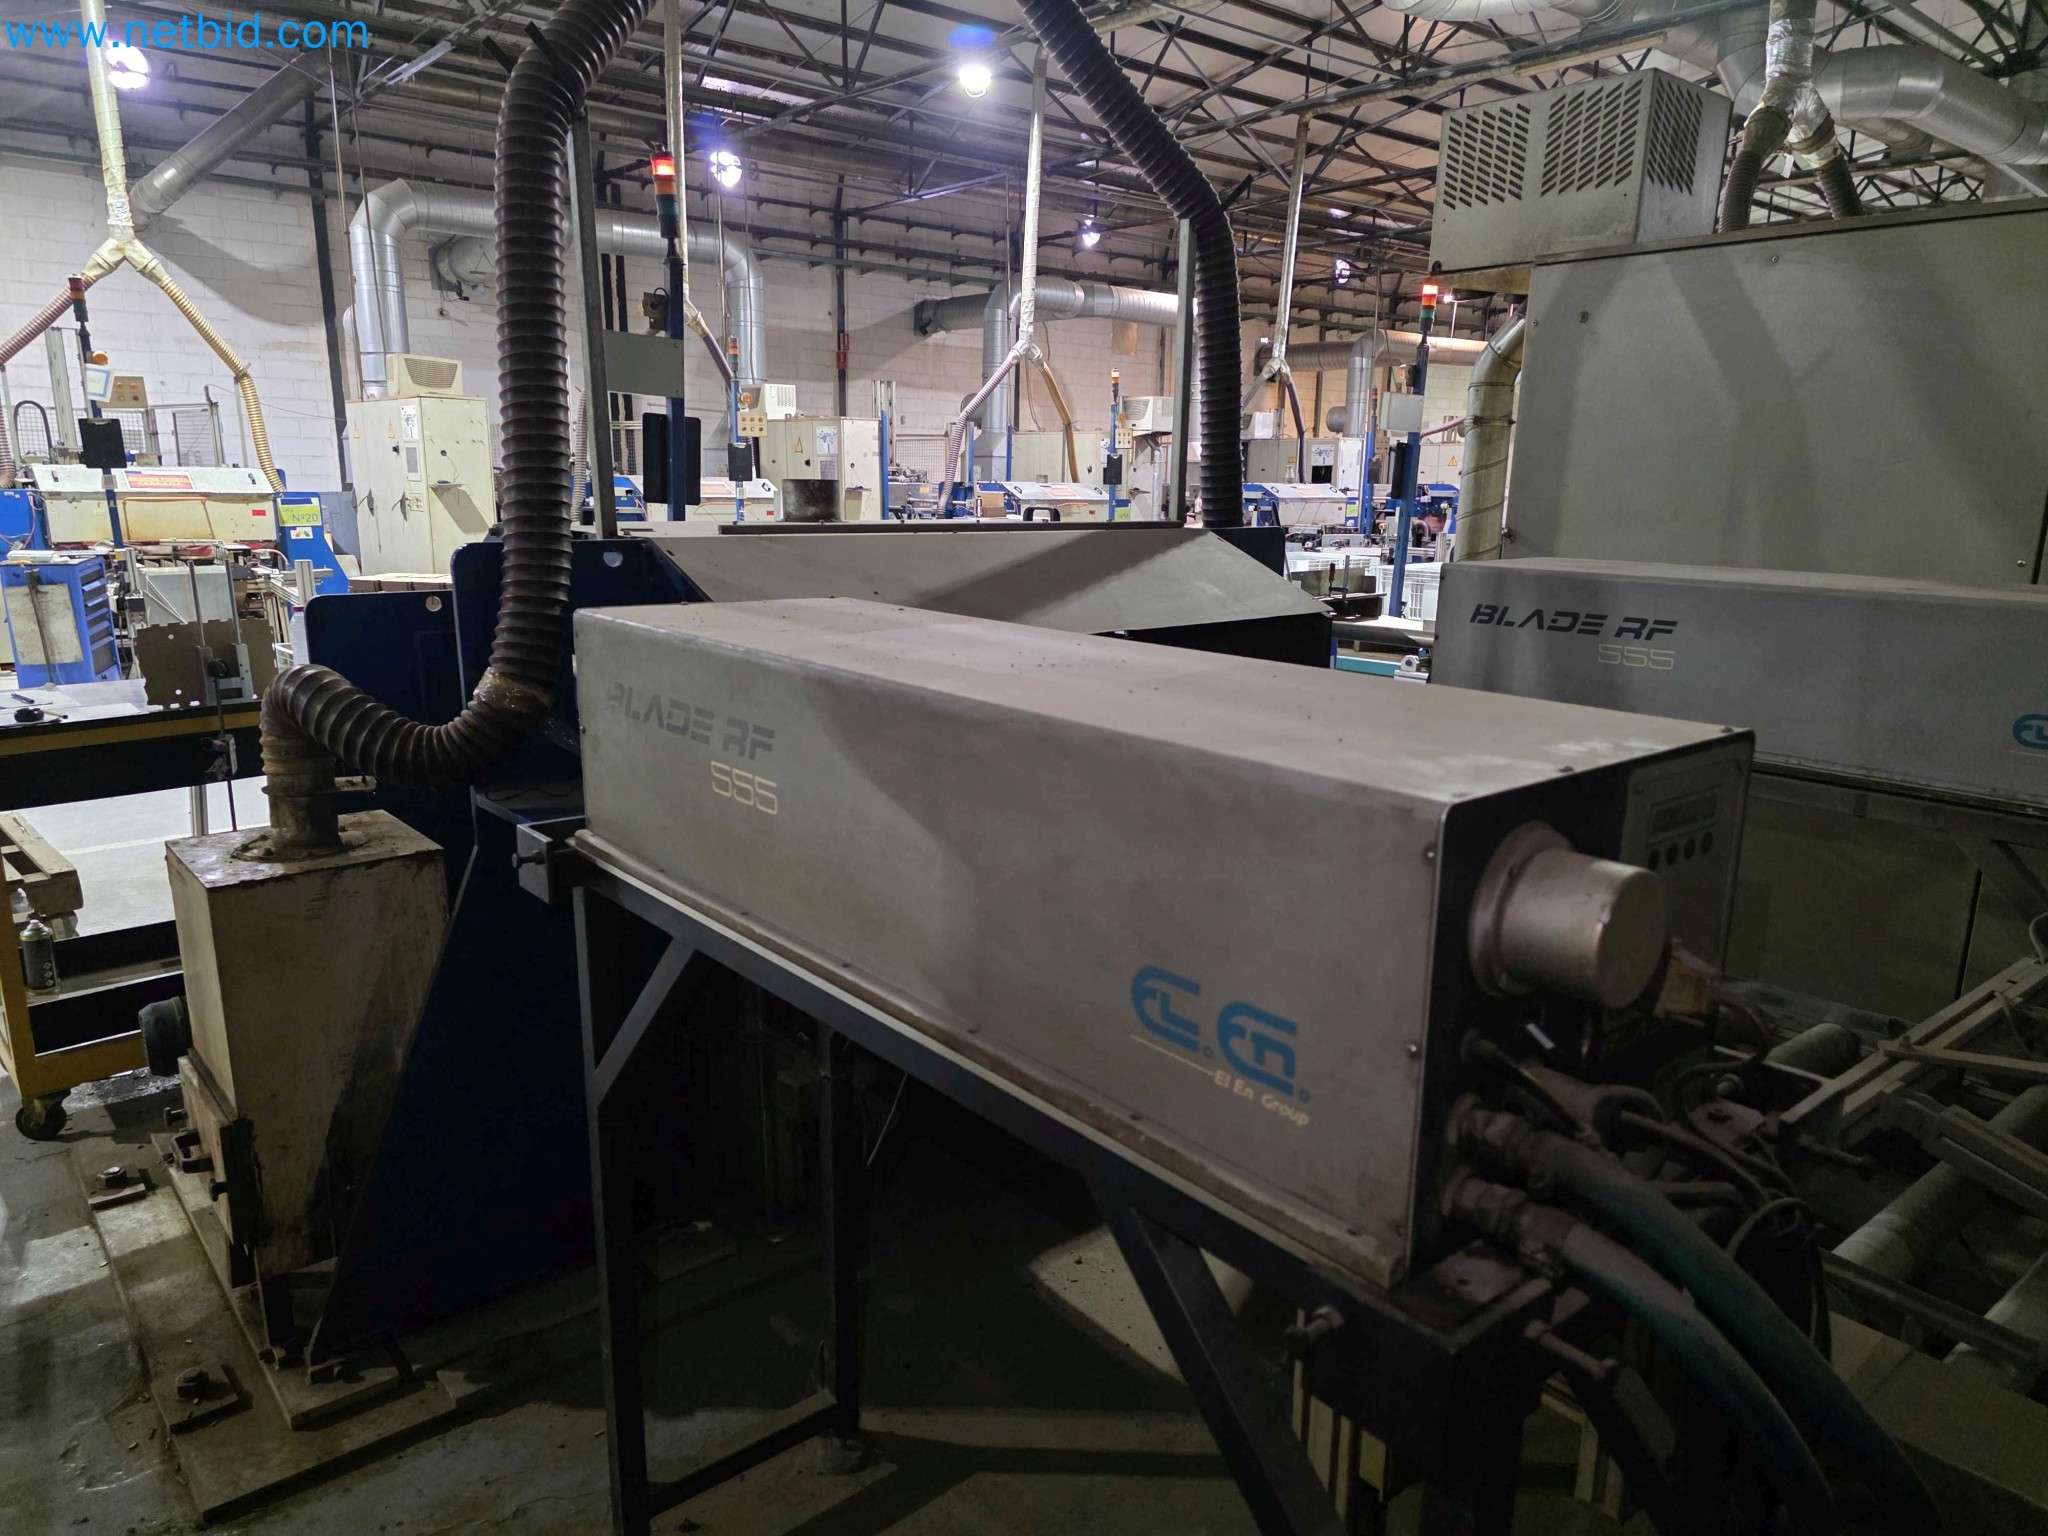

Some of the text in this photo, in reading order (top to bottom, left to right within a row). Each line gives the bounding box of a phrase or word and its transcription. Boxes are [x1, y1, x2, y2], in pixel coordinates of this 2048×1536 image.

[1470, 604, 1678, 641] BLADE RF
[605, 681, 776, 760] BLADE RF
[1261, 1094, 1311, 1127] Group
